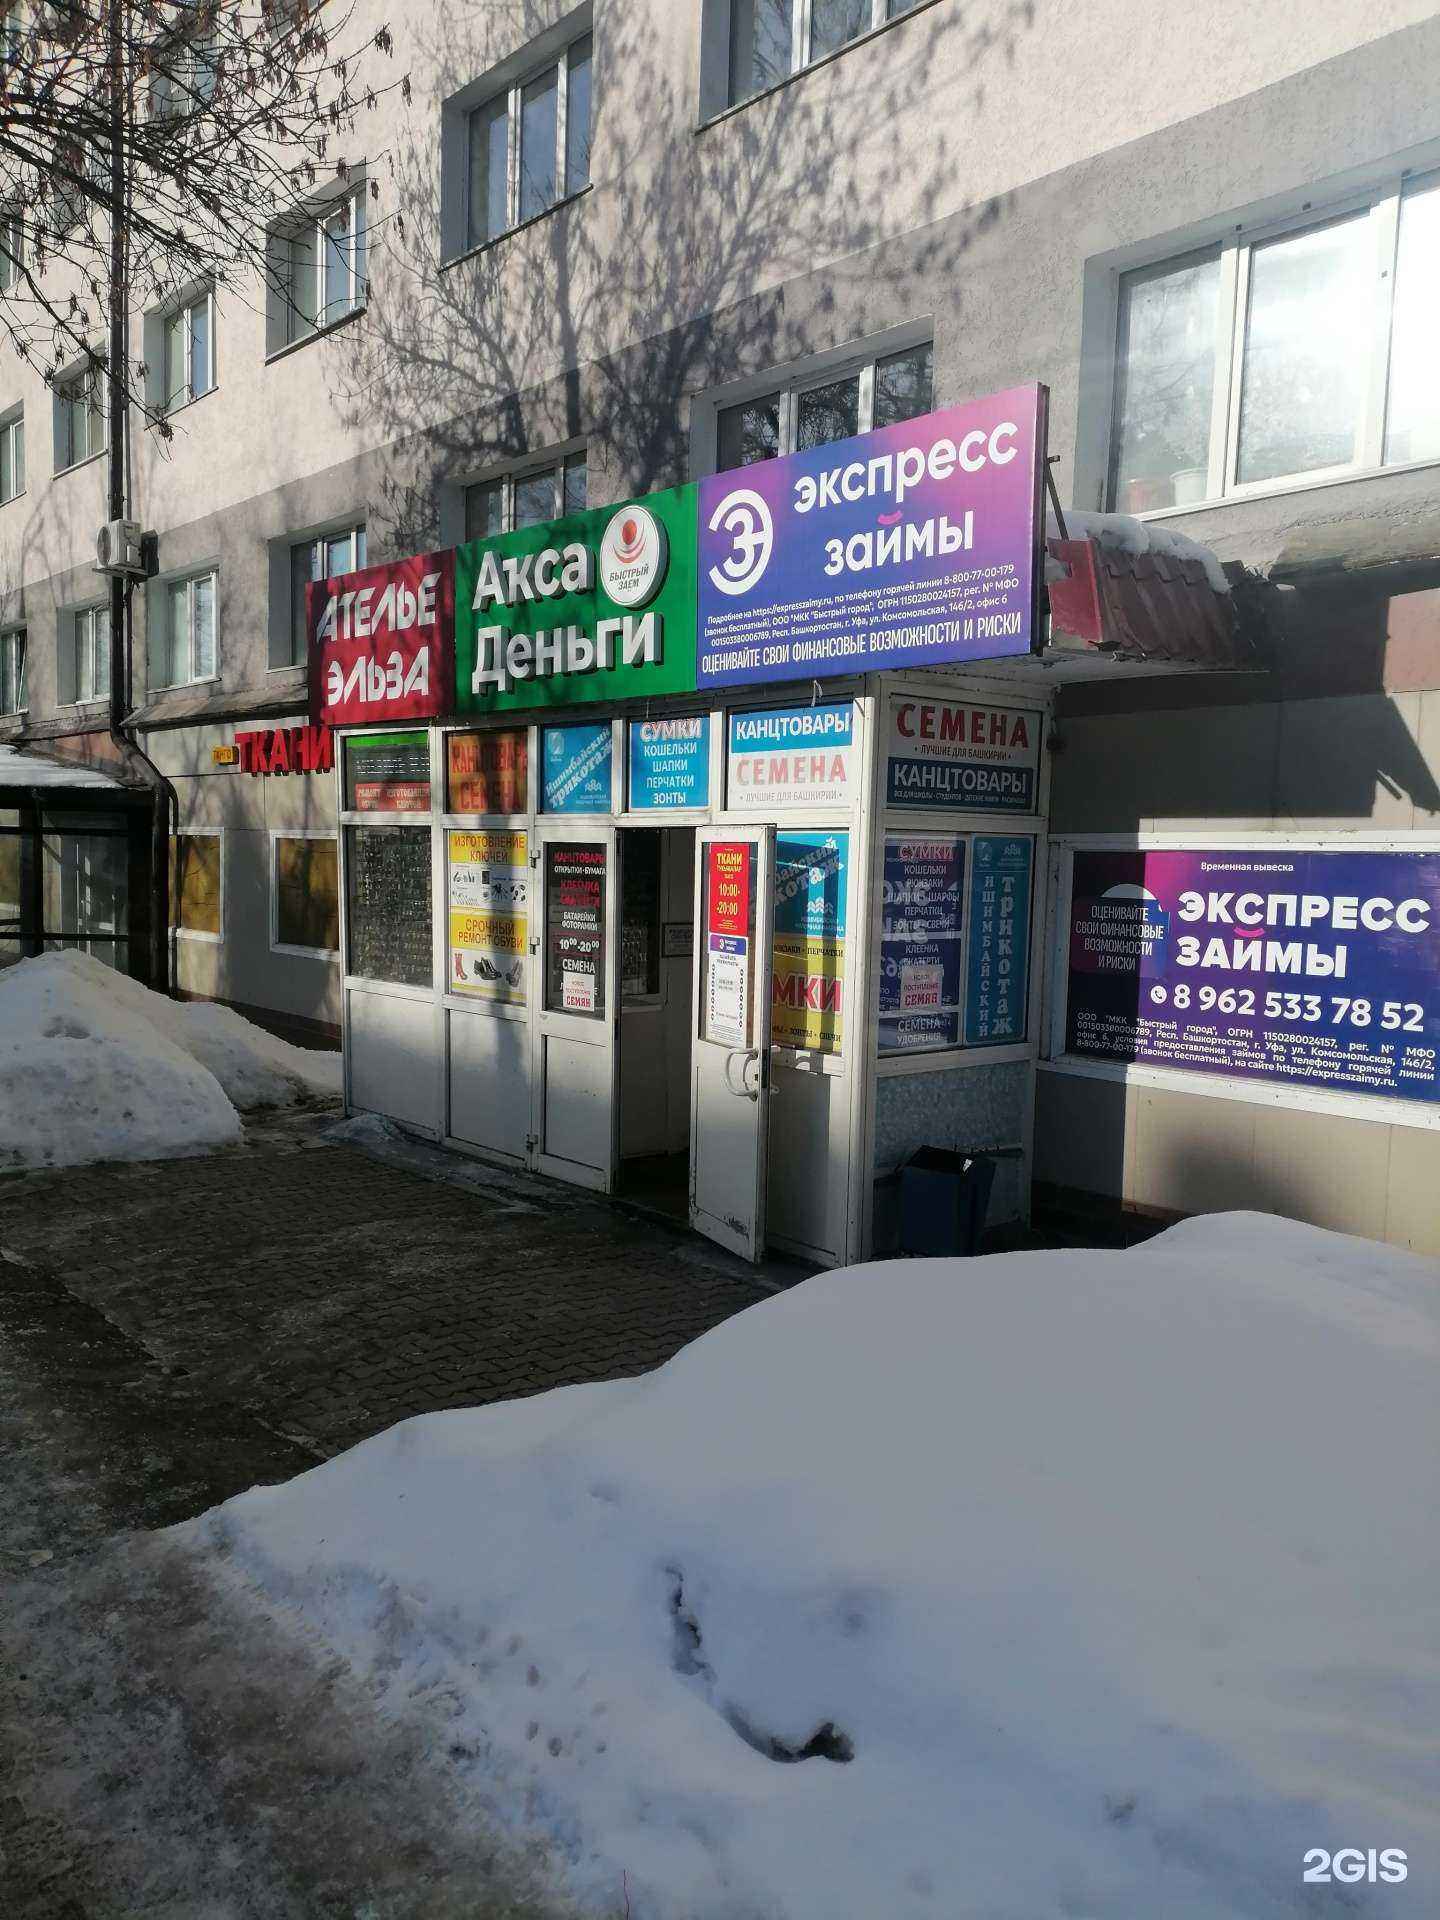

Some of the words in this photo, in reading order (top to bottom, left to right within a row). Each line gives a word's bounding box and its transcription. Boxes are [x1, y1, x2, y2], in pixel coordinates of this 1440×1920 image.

[794, 422, 1018, 513] экспресс
[823, 510, 974, 576] займы
[472, 543, 590, 610] Акса
[609, 565, 649, 583] БЫСТРЫЙ
[617, 579, 640, 592] ЗАЕМ
[708, 613, 743, 625] Подробнее
[743, 611, 752, 619] на
[834, 595, 844, 604] по
[845, 586, 881, 602] телефону
[883, 581, 916, 597] горячей
[916, 577, 943, 591] линии
[944, 564, 1015, 585] 8-800-77-00-179
[318, 572, 441, 642] АТЕЛЬЕ
[772, 616, 790, 626] ООО
[877, 598, 899, 610] ОГРН
[995, 577, 1019, 591] МФО
[851, 616, 868, 629] Уфа,
[976, 596, 1000, 609] офис
[1001, 594, 1008, 604] 6
[702, 647, 761, 675] ОЦЕНИВАЙТЕ
[762, 644, 790, 666] СВОИ
[792, 633, 866, 663] ФИНАНСОВЫЕ
[869, 620, 960, 652] ВОЗМОЖНОСТИ
[963, 619, 973, 640] И
[977, 612, 1021, 639] РИСКИ
[472, 612, 658, 695] Деньги
[327, 646, 430, 706] ЭЛЬЗА
[640, 718, 703, 742] СУМКИ
[736, 712, 849, 741] КАНЦТОВАРЫ
[896, 703, 1029, 748] СЕМЕНА
[235, 725, 333, 775] ТКАНИ
[644, 741, 697, 757] КОШЕЛЬКИ
[920, 744, 950, 756] ЛУЧШИЕ
[951, 747, 967, 759] ДЛЯ
[653, 760, 688, 773] ШАПКИ
[736, 754, 847, 786] СЕМЕНА
[646, 775, 694, 788] ПЕРЧАТКИ
[894, 763, 1027, 794] КАНЦТОВАРЫ
[653, 791, 686, 804] ЗОНТЫ
[746, 791, 775, 802] ЛУЧШИЕ
[777, 791, 793, 802] ДЛЯ
[455, 835, 525, 849] ИЗГОТОВЛЕНИЕ
[470, 850, 508, 862] КЛЮЧЕЙ
[716, 853, 742, 865] ТКАНИ
[904, 865, 947, 875] КОШЕЛЬКИ
[1200, 862, 1252, 872] Временная
[1253, 862, 1294, 872] вывеска
[563, 911, 596, 922] БАТАРЕЙКИ
[904, 906, 943, 916] ПЕРЧАТКИ
[1091, 903, 1149, 922] ОЦЕНИВАЙТЕ
[1177, 891, 1431, 933] ЭКСПРЕСС
[465, 918, 515, 934] СРОЧНЫЙ
[561, 920, 599, 931] ФОТОРАМКИ
[1075, 920, 1099, 935] СВОИ
[1100, 921, 1164, 940] ФИНАНСОВЫЕ
[458, 932, 492, 944] РЕМОНТ
[493, 936, 523, 950] ОБУВИ
[1083, 938, 1153, 956] ВОЗМОЖНОСТИ
[562, 958, 596, 974] СЕМЕНА
[1098, 955, 1105, 969] И
[1105, 955, 1136, 970] РИСКИ
[566, 996, 591, 1008] СЕМЯН
[773, 971, 843, 1014] МКИ
[1173, 984, 1191, 1009] 8
[1198, 986, 1256, 1016] 962
[1263, 992, 1322, 1022] 533
[1331, 998, 1372, 1027] 78
[1380, 1002, 1424, 1033] 52
[1077, 1012, 1097, 1021] ООО
[1227, 1027, 1253, 1039] ОГРН
[1349, 1042, 1370, 1052] рег.
[1406, 1046, 1436, 1059] МФО
[1115, 1035, 1148, 1046] условия
[1153, 1040, 1226, 1055] предоставления
[1232, 1048, 1266, 1060] займов
[1273, 1053, 1286, 1062] по
[1292, 1056, 1341, 1070] телефону
[1348, 1062, 1391, 1075] горячей
[1399, 1069, 1435, 1081] линии
[1156, 1029, 1179, 1040] Респ.
[1265, 1041, 1287, 1054] Уфа,
[1291, 1046, 1306, 1056] ул.
[1311, 1046, 1396, 1067] Комсомольская,
[1401, 1057, 1435, 1070] 146/2,
[1234, 1059, 1247, 1068] на
[1247, 1059, 1274, 1071] сайте
